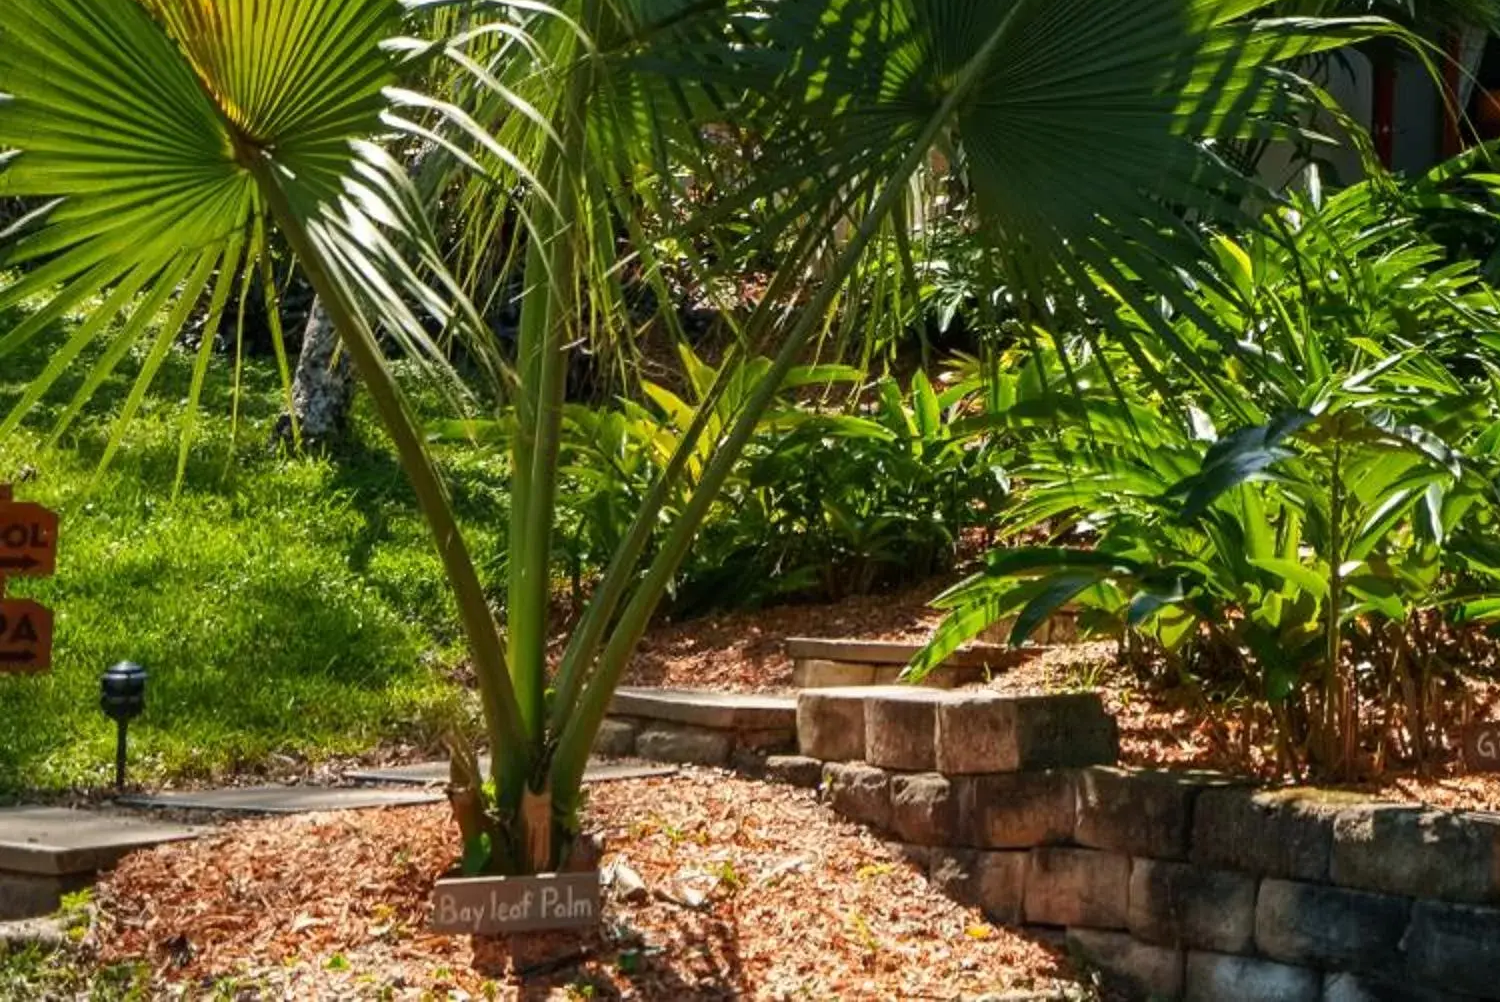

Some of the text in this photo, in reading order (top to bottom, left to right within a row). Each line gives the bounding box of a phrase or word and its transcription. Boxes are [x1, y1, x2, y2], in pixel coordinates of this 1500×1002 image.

[440, 885, 592, 930] Bay leaf Palm
